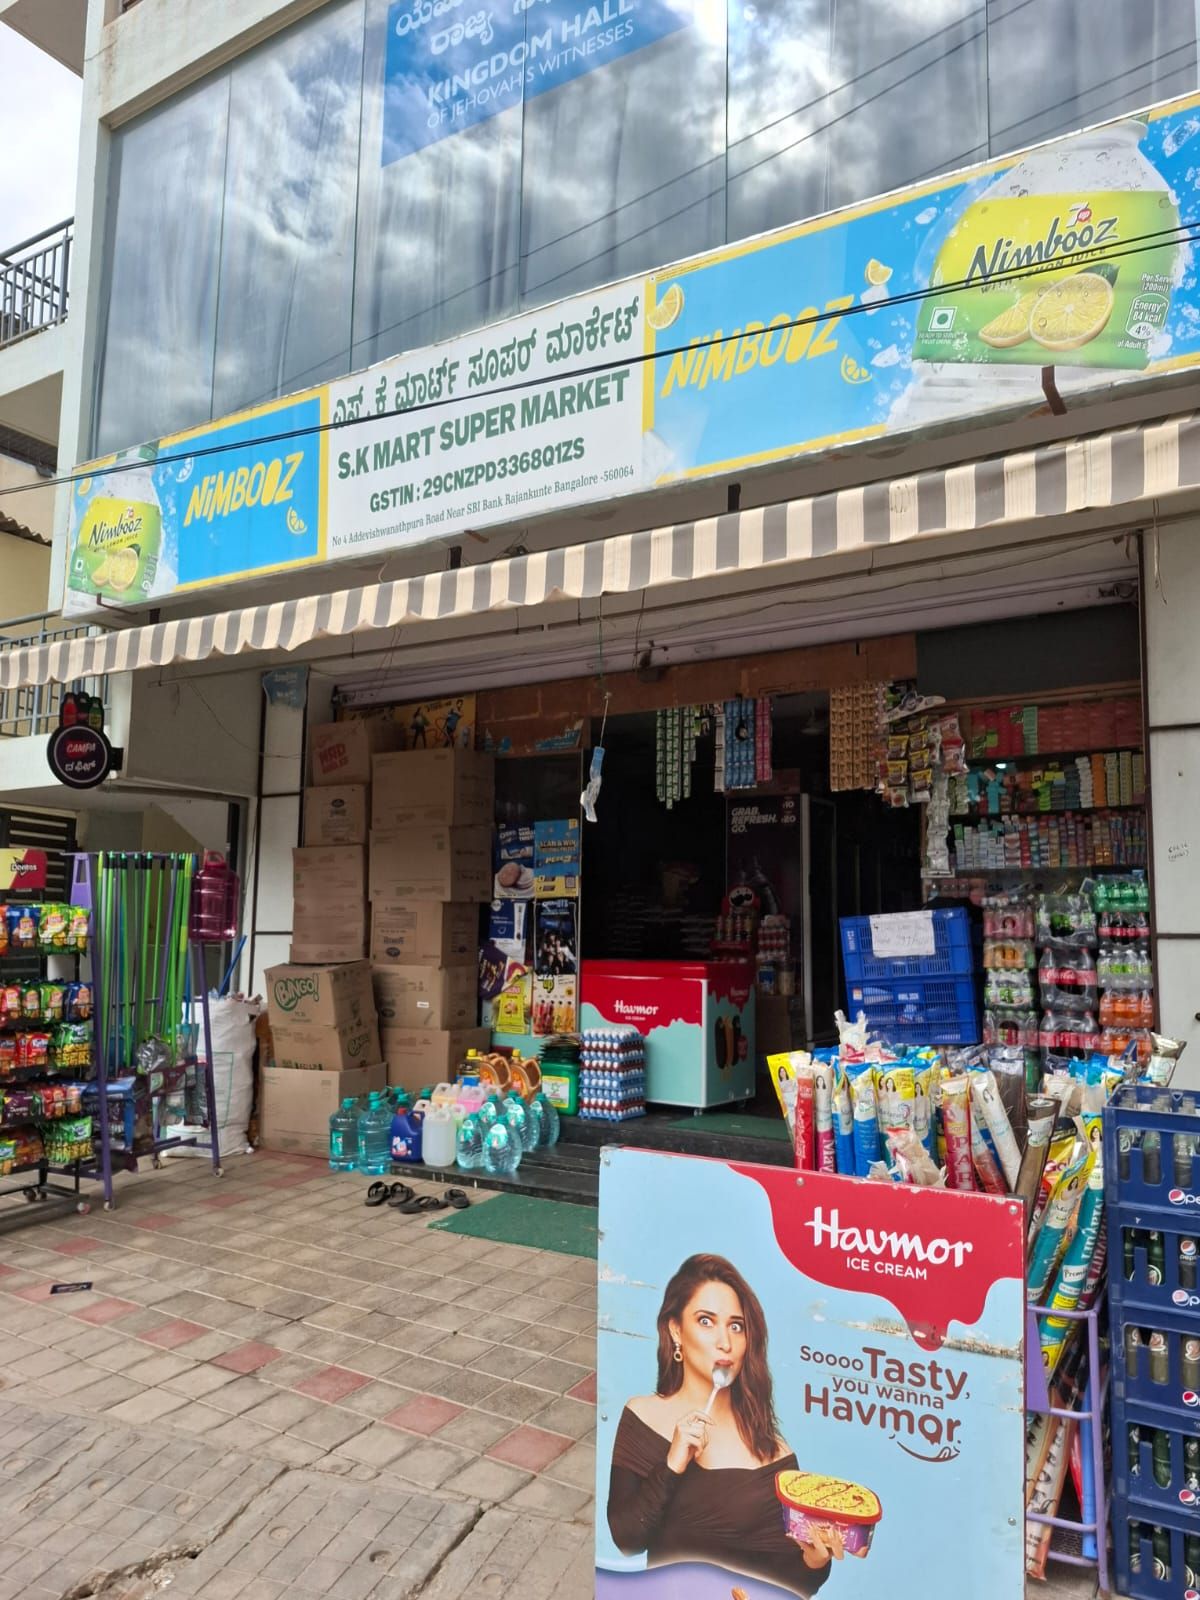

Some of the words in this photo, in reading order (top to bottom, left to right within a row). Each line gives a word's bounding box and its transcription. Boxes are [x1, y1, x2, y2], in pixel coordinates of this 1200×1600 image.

[427, 28, 552, 107] KINGDOM
[561, 0, 635, 43] HALL
[427, 107, 448, 128] OF
[450, 66, 535, 123] JEHOVAHS
[538, 19, 634, 75] WITNESSES
[964, 216, 1119, 288] Nimbooz
[468, 328, 537, 389] ಸೂಪರ್
[338, 446, 369, 480] S.K
[373, 426, 435, 471] MART
[439, 402, 516, 451] SUPER
[520, 368, 631, 428] MARKET
[88, 513, 143, 548] Nimbooz
[332, 536, 342, 546] No
[425, 511, 445, 525] Road
[446, 507, 465, 520] Near
[466, 500, 481, 515] SBI
[483, 497, 503, 512] Bank
[505, 484, 553, 505] Rajankunte
[554, 474, 598, 494] Bangalore
[613, 1000, 660, 1016] Havmor
[804, 1206, 973, 1268] Havmor
[846, 1257, 870, 1272] ICE
[874, 1261, 928, 1281] CREAM
[800, 1344, 864, 1372] Soooo
[862, 1346, 971, 1401] Tasty,
[832, 1376, 869, 1396] you
[876, 1384, 945, 1411] wanna
